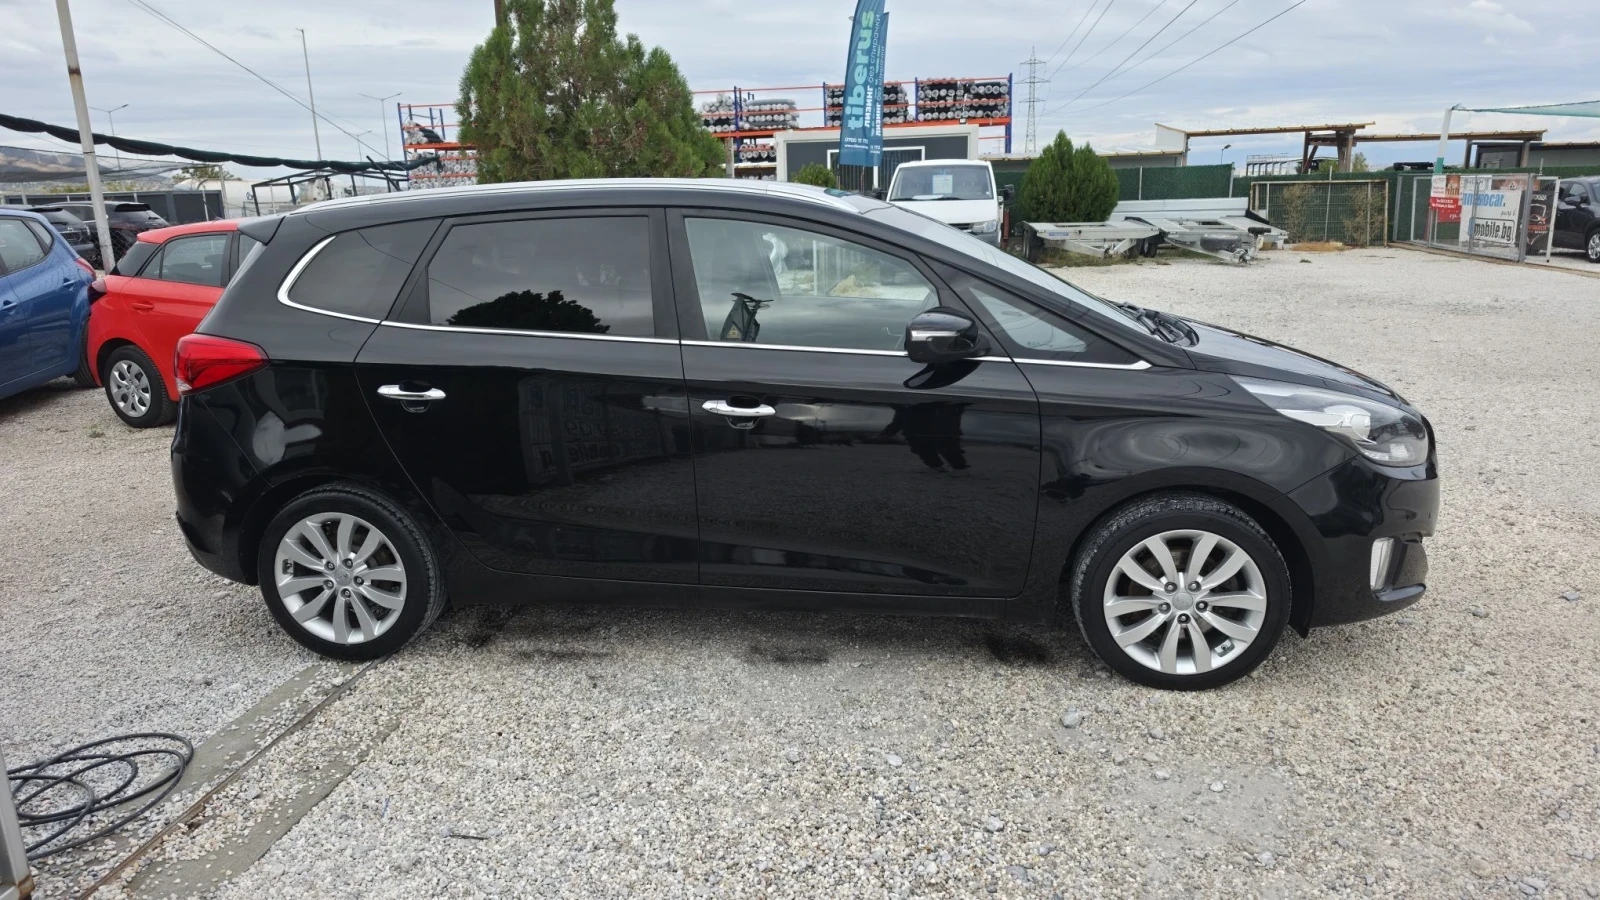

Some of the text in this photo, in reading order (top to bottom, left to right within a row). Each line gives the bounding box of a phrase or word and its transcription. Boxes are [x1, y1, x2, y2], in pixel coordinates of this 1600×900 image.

[845, 11, 874, 130] tiberus
[864, 85, 874, 128] лизинг
[1474, 221, 1513, 242] mobile.bg
